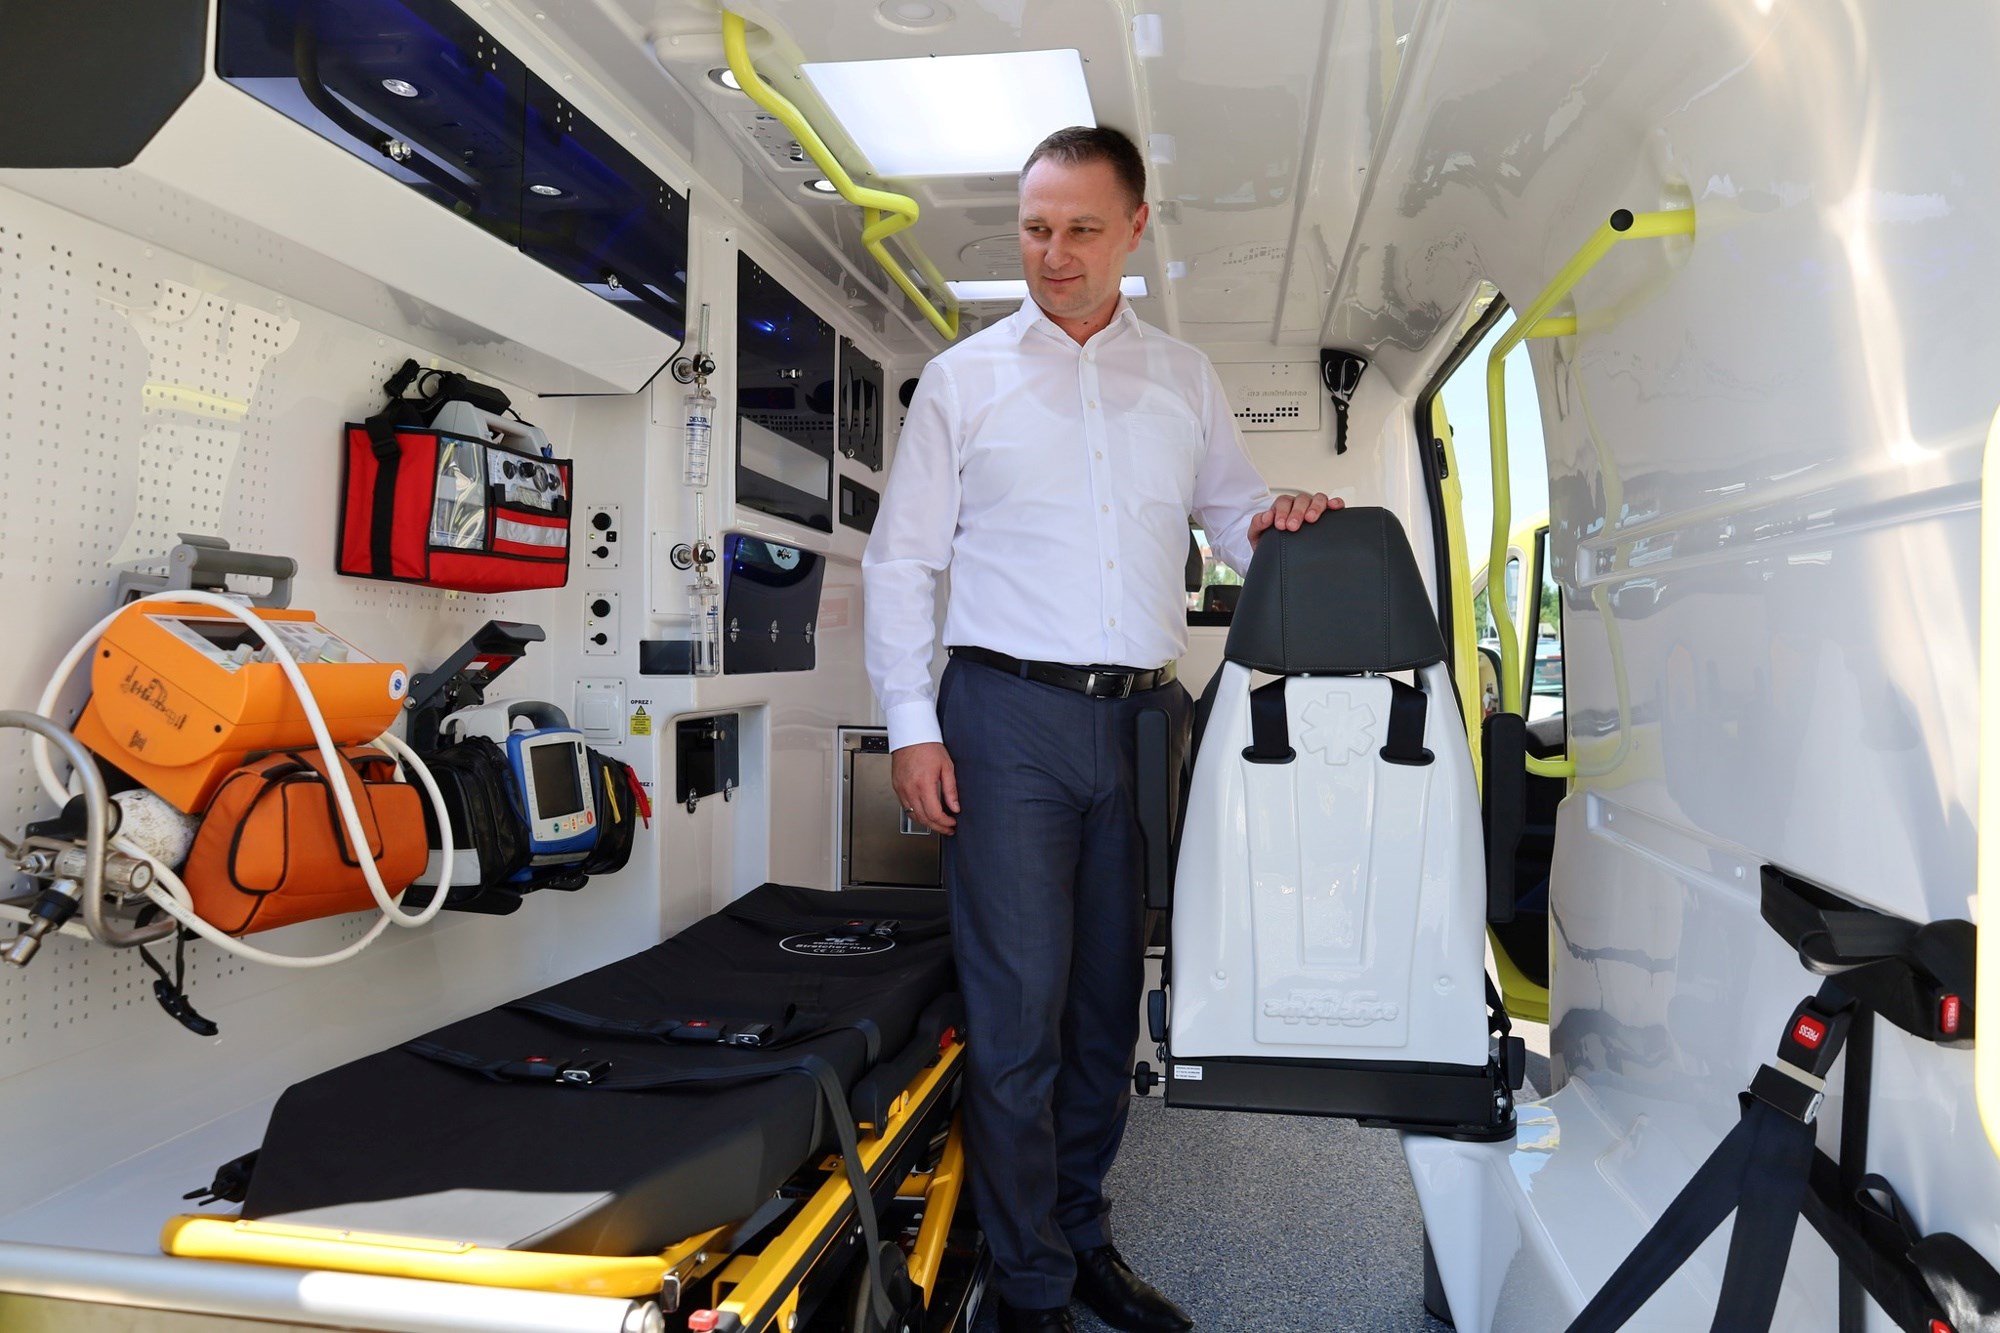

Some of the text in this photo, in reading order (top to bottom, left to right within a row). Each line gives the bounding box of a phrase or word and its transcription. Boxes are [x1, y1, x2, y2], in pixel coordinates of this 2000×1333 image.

[689, 416, 708, 424] DELTA
[1947, 1002, 1956, 1028] PRESS
[1798, 1024, 1819, 1042] PRESS
